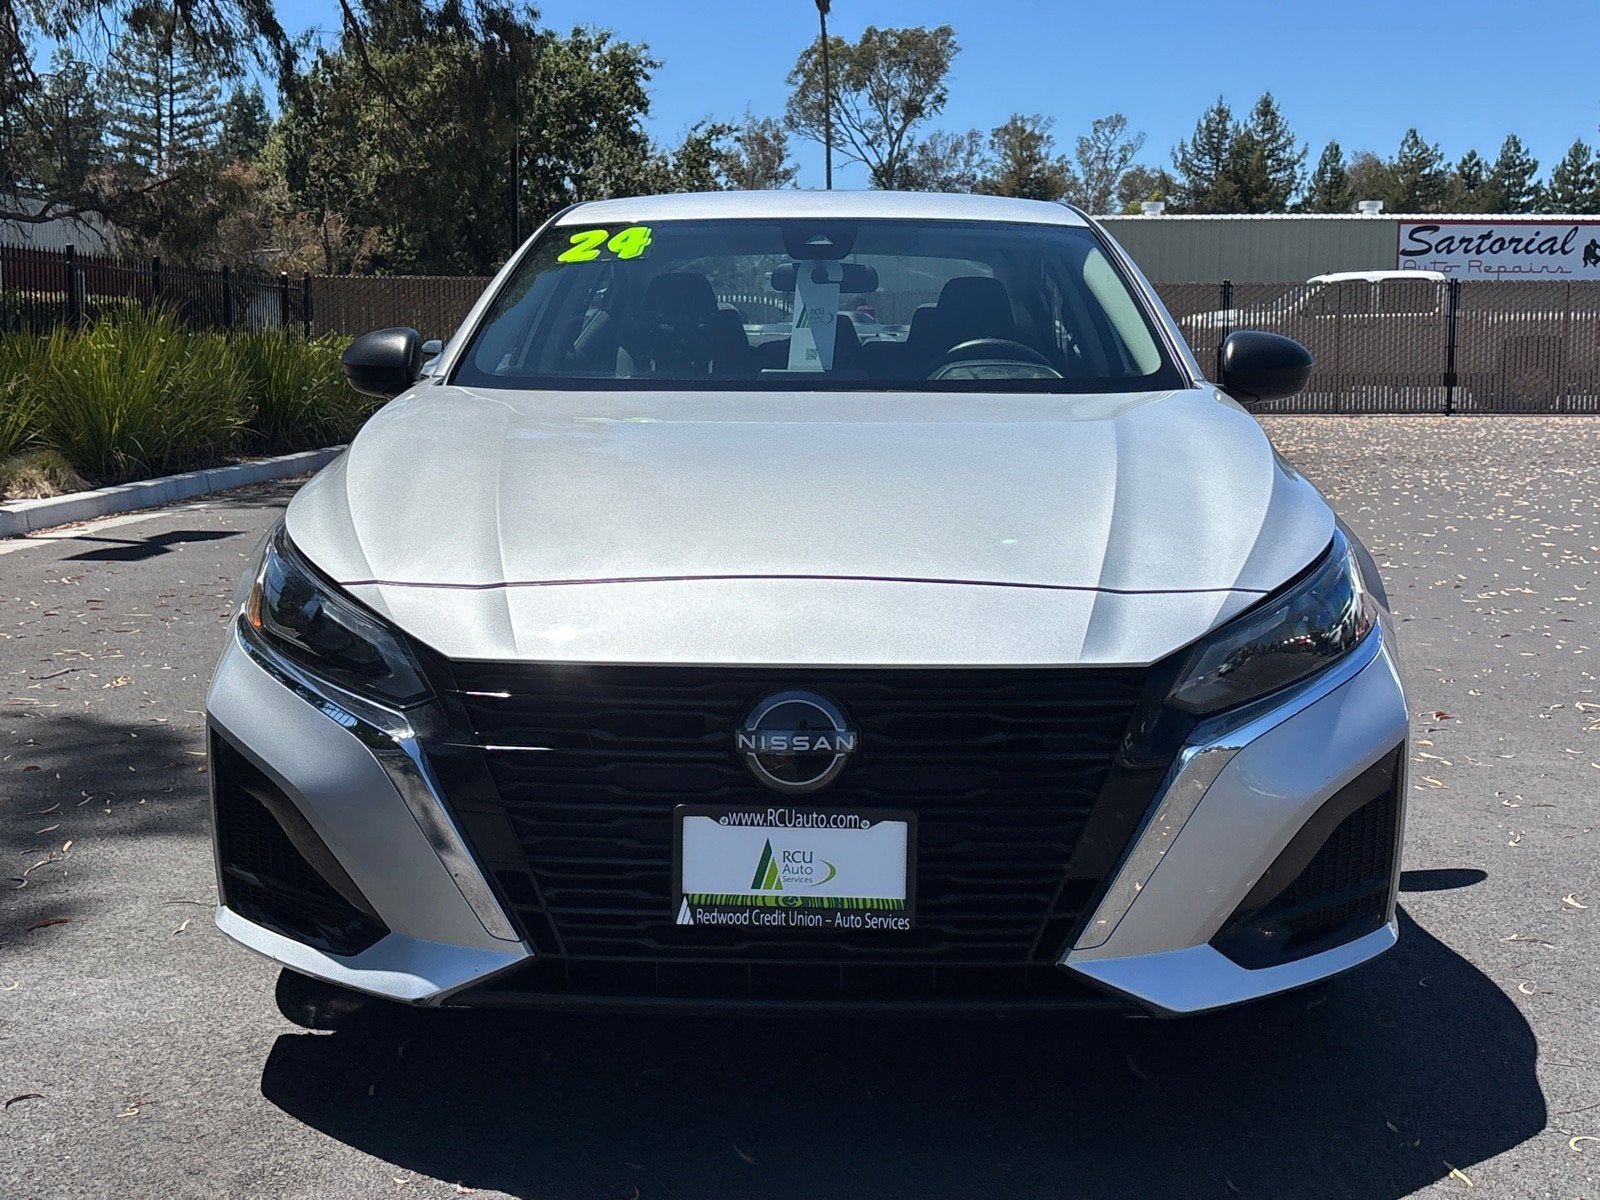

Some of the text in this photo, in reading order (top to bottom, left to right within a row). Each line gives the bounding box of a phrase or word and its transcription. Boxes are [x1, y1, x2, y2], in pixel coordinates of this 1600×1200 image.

[557, 226, 652, 263] 24
[1399, 225, 1579, 257] Sartorial
[1403, 259, 1572, 281] Auto Repairs
[738, 734, 854, 751] NISSAN
[728, 808, 860, 829] www.RCUauto.com
[782, 850, 813, 864] RCU
[782, 864, 813, 876] Auto
[782, 875, 813, 884] Services
[696, 909, 749, 926] Redwood
[752, 910, 786, 927] Credit
[788, 912, 822, 927] Union
[834, 913, 862, 928] Auto
[865, 912, 910, 930] Services
